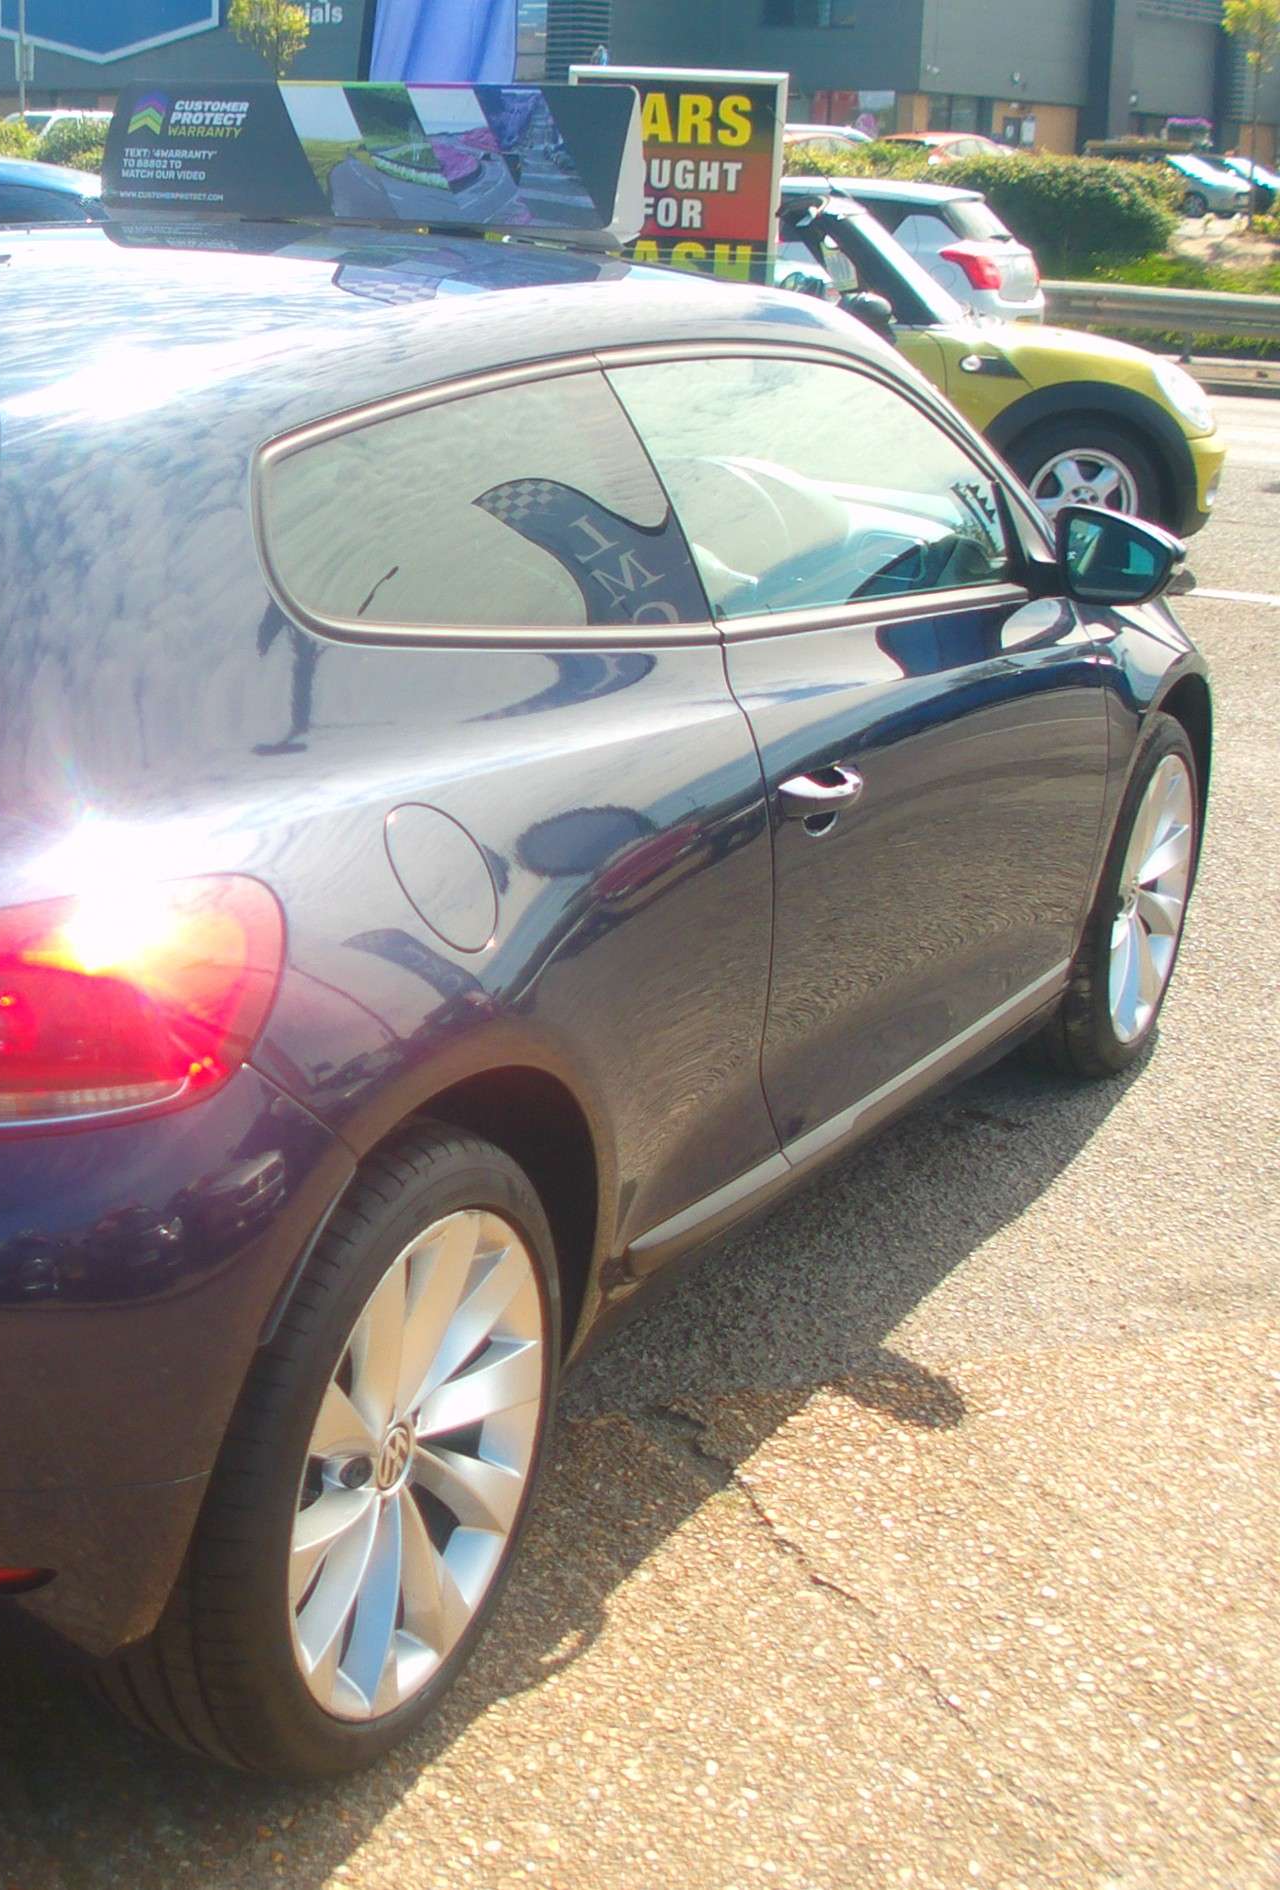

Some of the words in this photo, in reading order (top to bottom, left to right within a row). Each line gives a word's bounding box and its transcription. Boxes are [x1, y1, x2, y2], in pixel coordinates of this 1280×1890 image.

[174, 100, 250, 112] CUSTOMER
[170, 112, 247, 126] PROTECT
[641, 92, 753, 147] ARS
[168, 126, 242, 138] WARRANTY
[122, 159, 135, 168] TO
[169, 160, 182, 170] TO
[121, 169, 154, 179] WATCH
[155, 170, 176, 179] OUR
[177, 171, 207, 181] VIDEO
